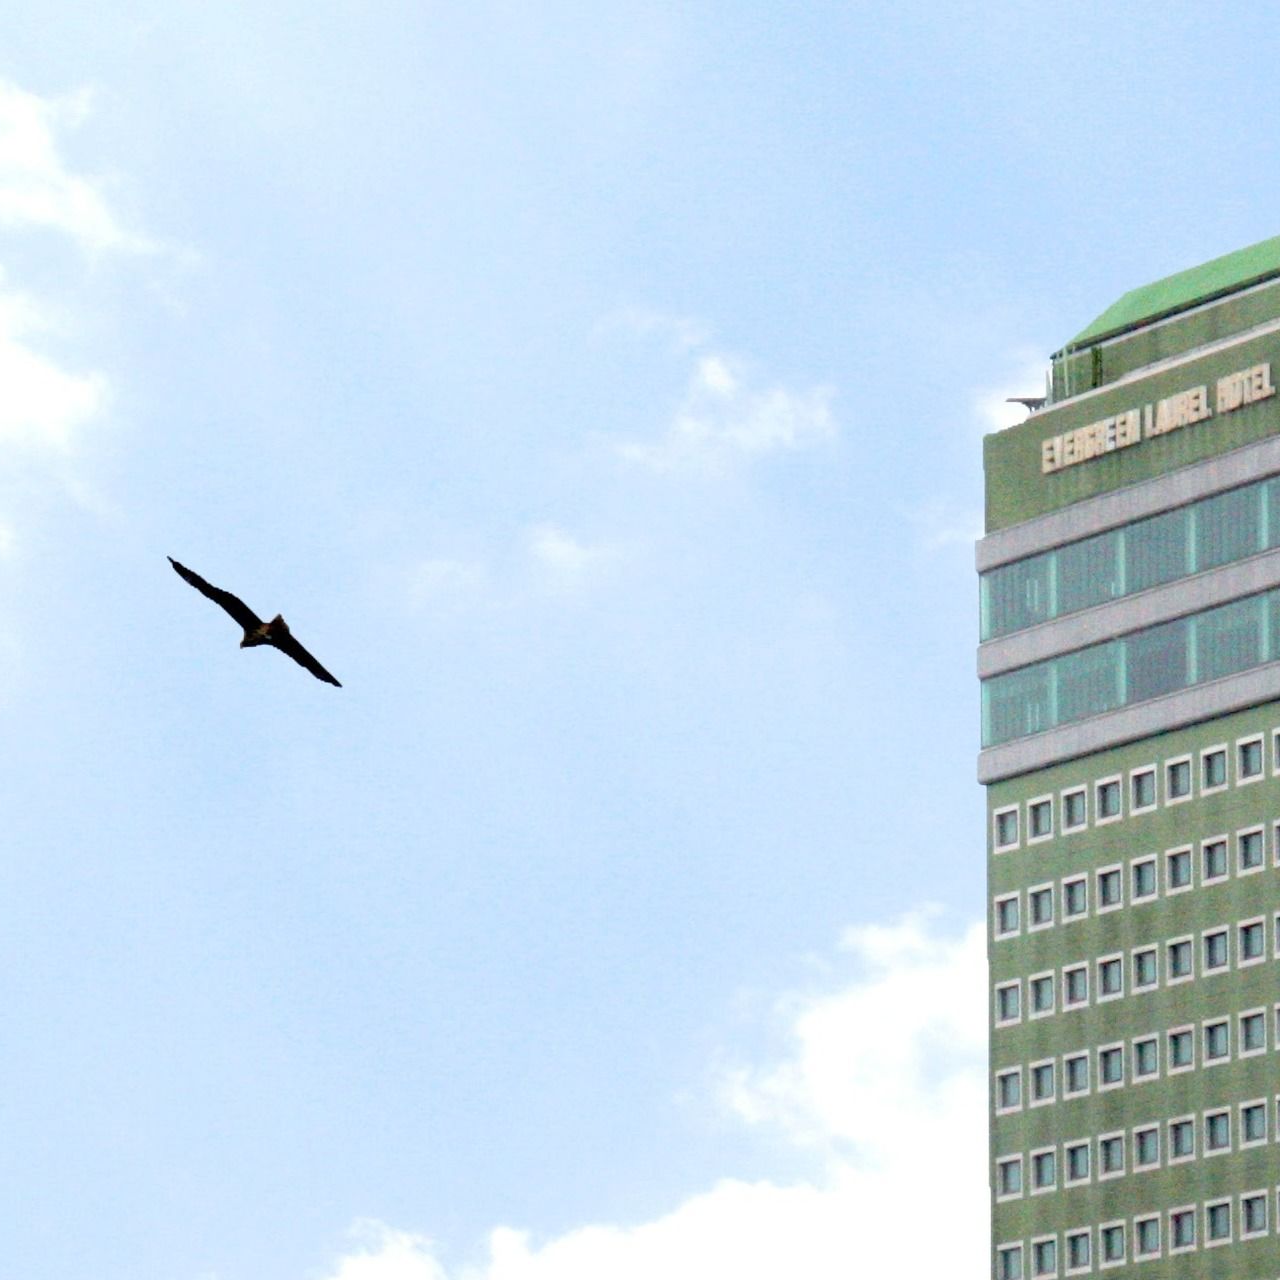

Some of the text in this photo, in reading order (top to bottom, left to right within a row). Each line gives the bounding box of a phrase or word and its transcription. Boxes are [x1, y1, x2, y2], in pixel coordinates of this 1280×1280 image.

[1041, 362, 1276, 475] EVERGREEN LAUREL HOTEL
